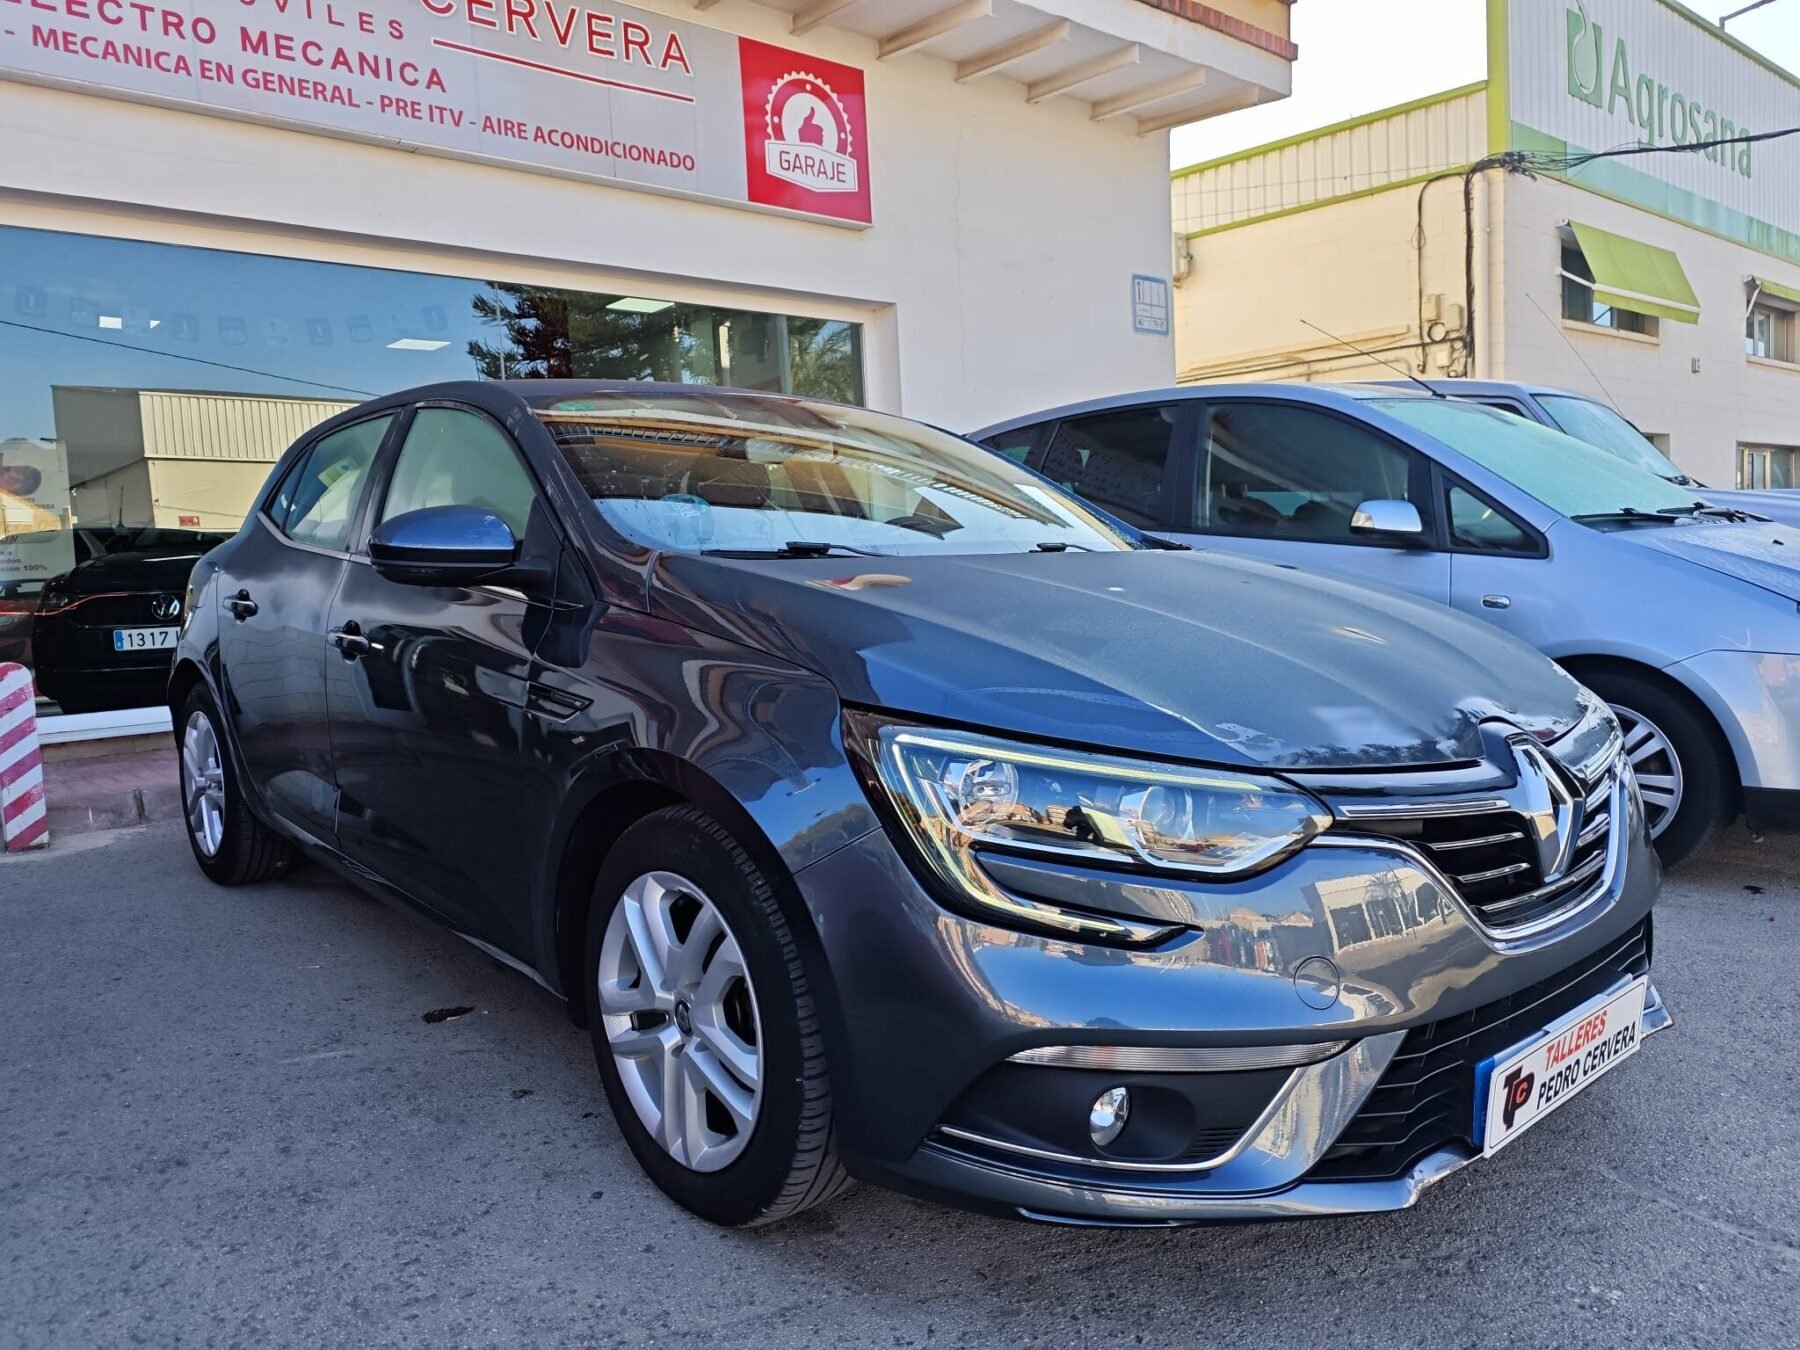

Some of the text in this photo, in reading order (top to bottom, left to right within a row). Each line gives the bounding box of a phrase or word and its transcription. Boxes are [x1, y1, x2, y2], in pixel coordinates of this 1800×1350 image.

[239, 0, 404, 40] VILES
[240, 26, 447, 93] MECANICA
[32, 24, 193, 77] MECANICA
[199, 59, 235, 84] EN
[241, 68, 361, 108] GENERAL
[379, 95, 423, 120] PRE
[428, 104, 463, 128] ITV
[482, 115, 528, 140] AIRE
[533, 126, 695, 171] ACONDICIONADO
[1608, 37, 1752, 178] Agrosana
[779, 150, 847, 183] GARAJE
[128, 631, 168, 647] 1317
[1537, 1021, 1635, 1110] PEDRO CERVERA
[1545, 1010, 1607, 1071] TALLERES
